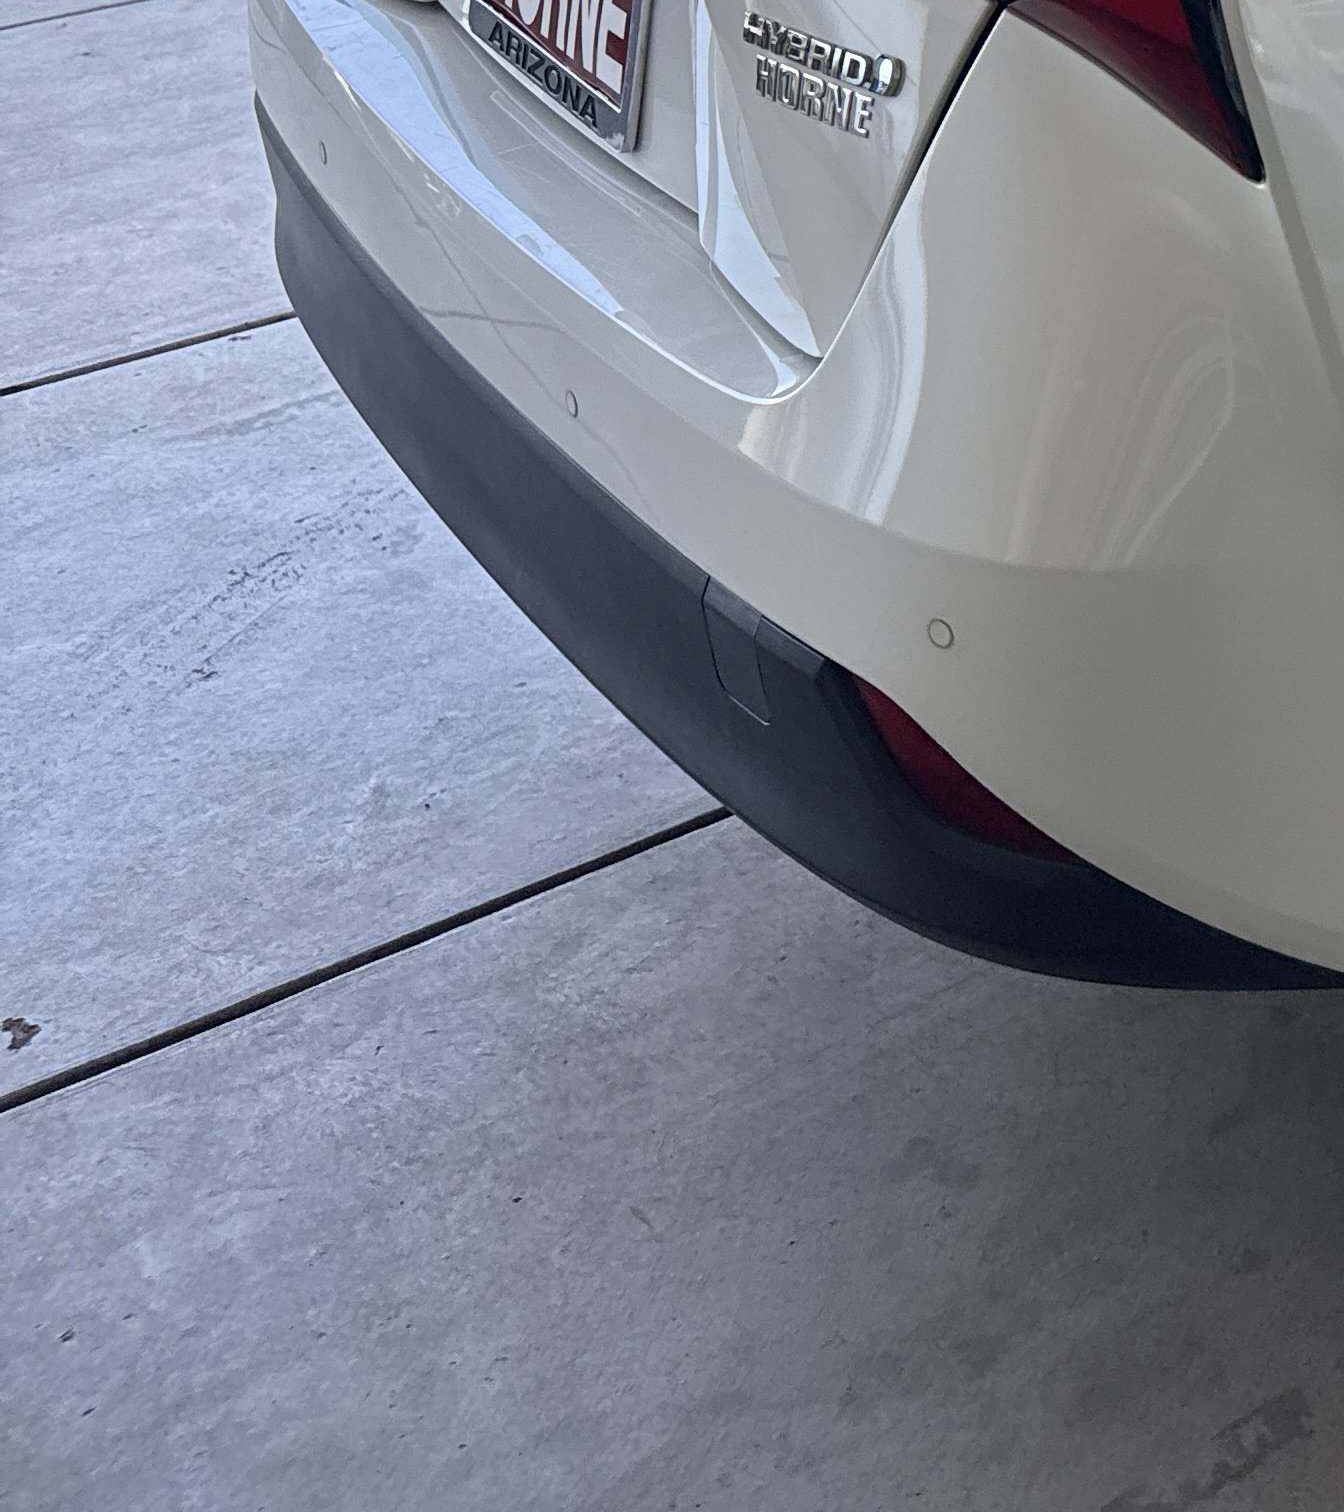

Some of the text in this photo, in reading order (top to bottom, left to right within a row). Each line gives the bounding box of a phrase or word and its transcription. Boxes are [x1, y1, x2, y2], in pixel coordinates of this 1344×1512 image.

[487, 20, 600, 129] ARIZONA
[742, 10, 874, 90] HYBRID
[755, 54, 875, 139] HORNE
